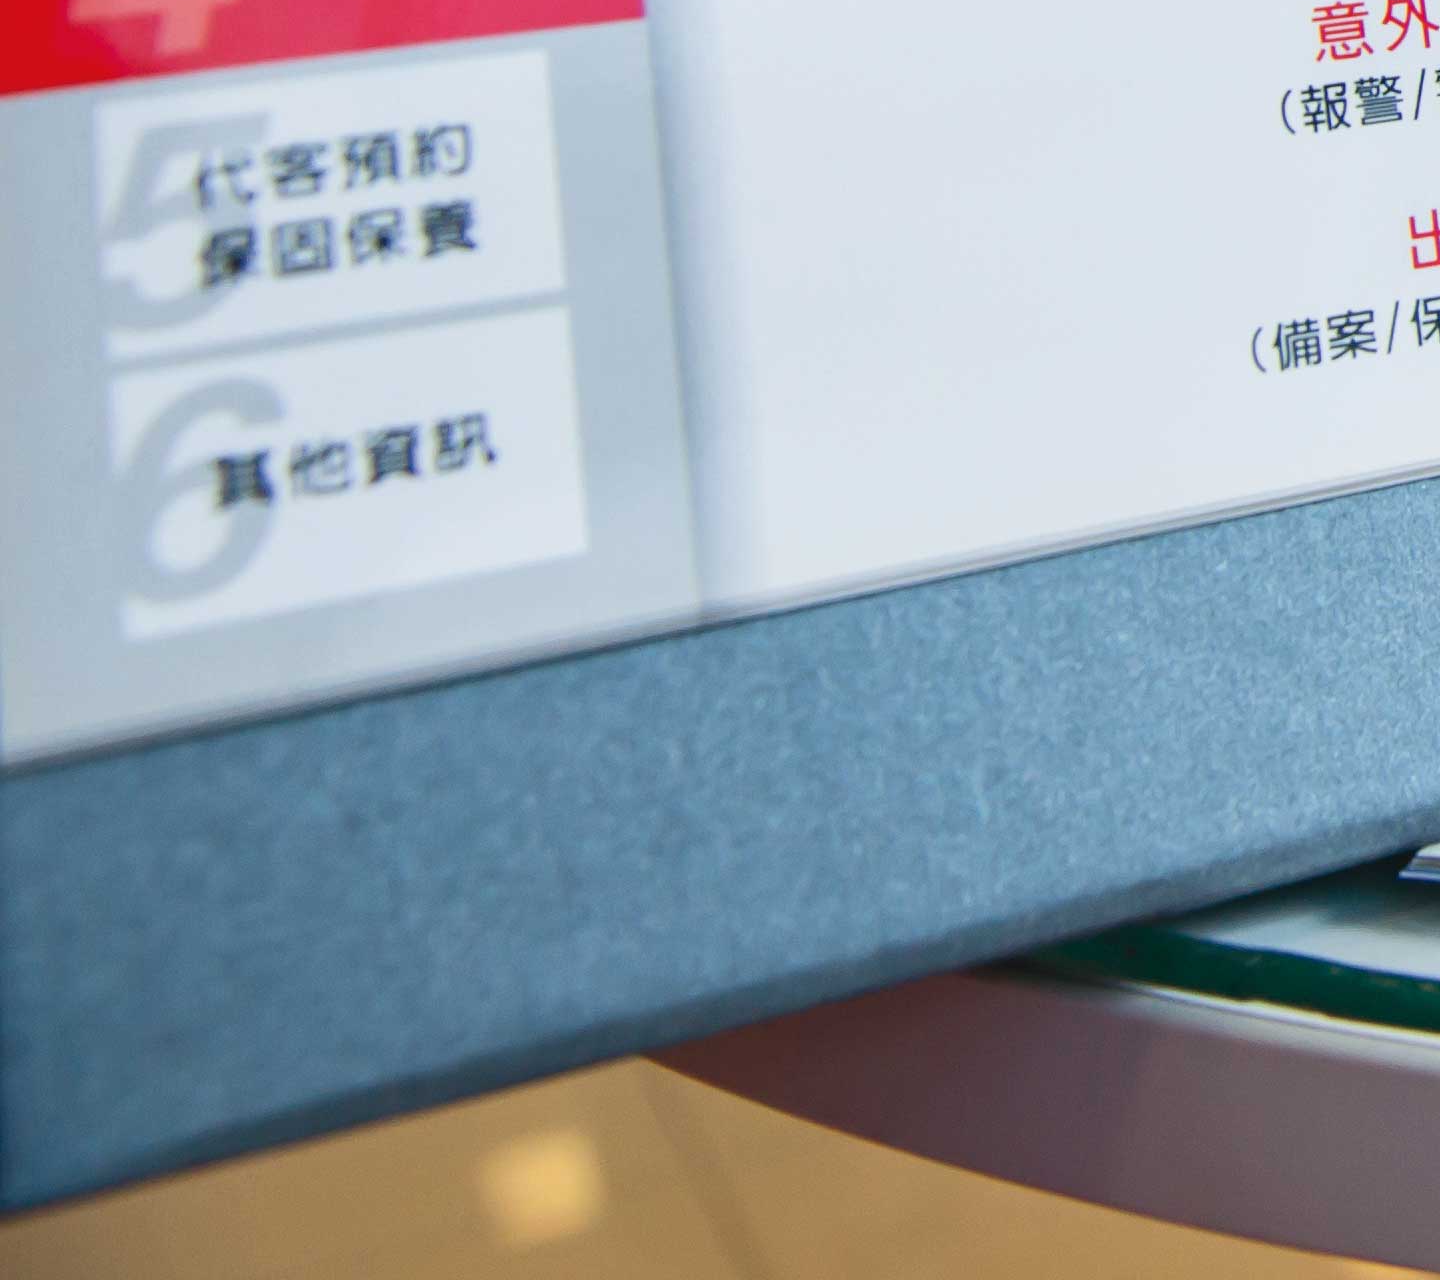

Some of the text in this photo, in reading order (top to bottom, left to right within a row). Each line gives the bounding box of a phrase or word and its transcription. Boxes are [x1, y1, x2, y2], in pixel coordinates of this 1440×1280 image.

[192, 122, 475, 208] 代客預約
[196, 198, 480, 290] 保固保養
[211, 412, 498, 511] 其他資訊
